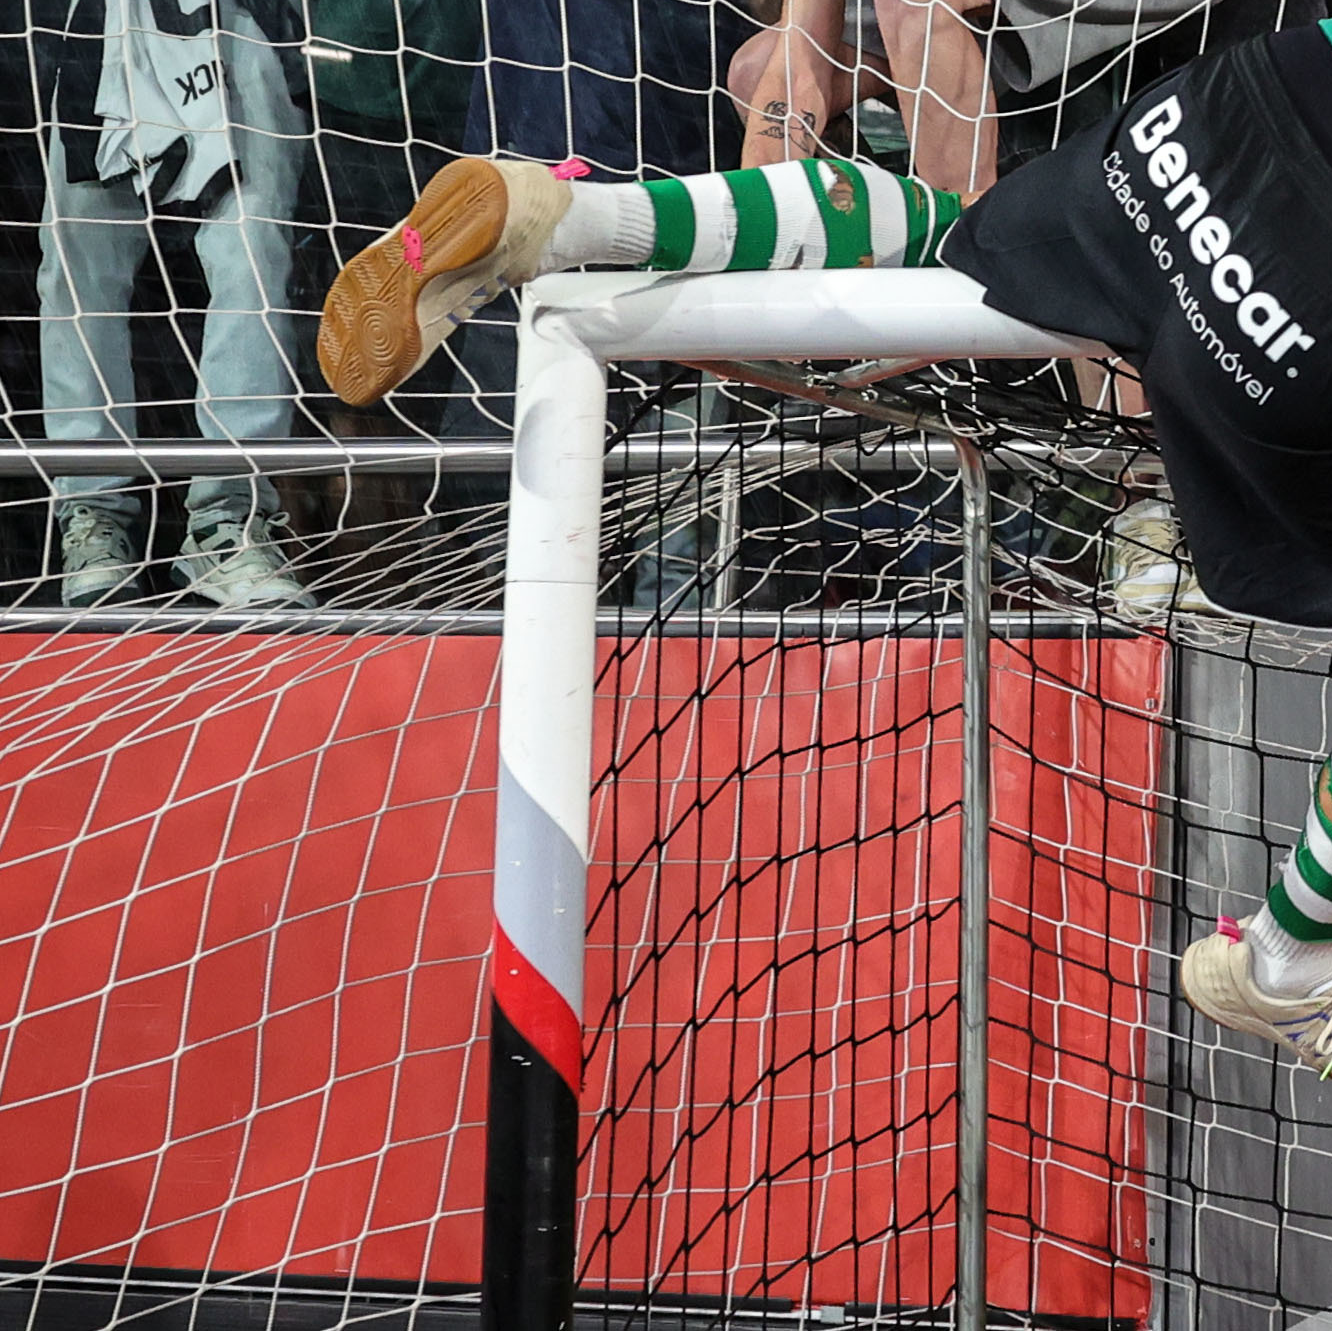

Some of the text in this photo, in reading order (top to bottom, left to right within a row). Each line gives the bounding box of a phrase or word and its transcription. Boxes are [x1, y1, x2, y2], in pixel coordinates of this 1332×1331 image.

[1103, 151, 1275, 406] Cidade do Automóvel
[1129, 94, 1316, 363] Benecar
